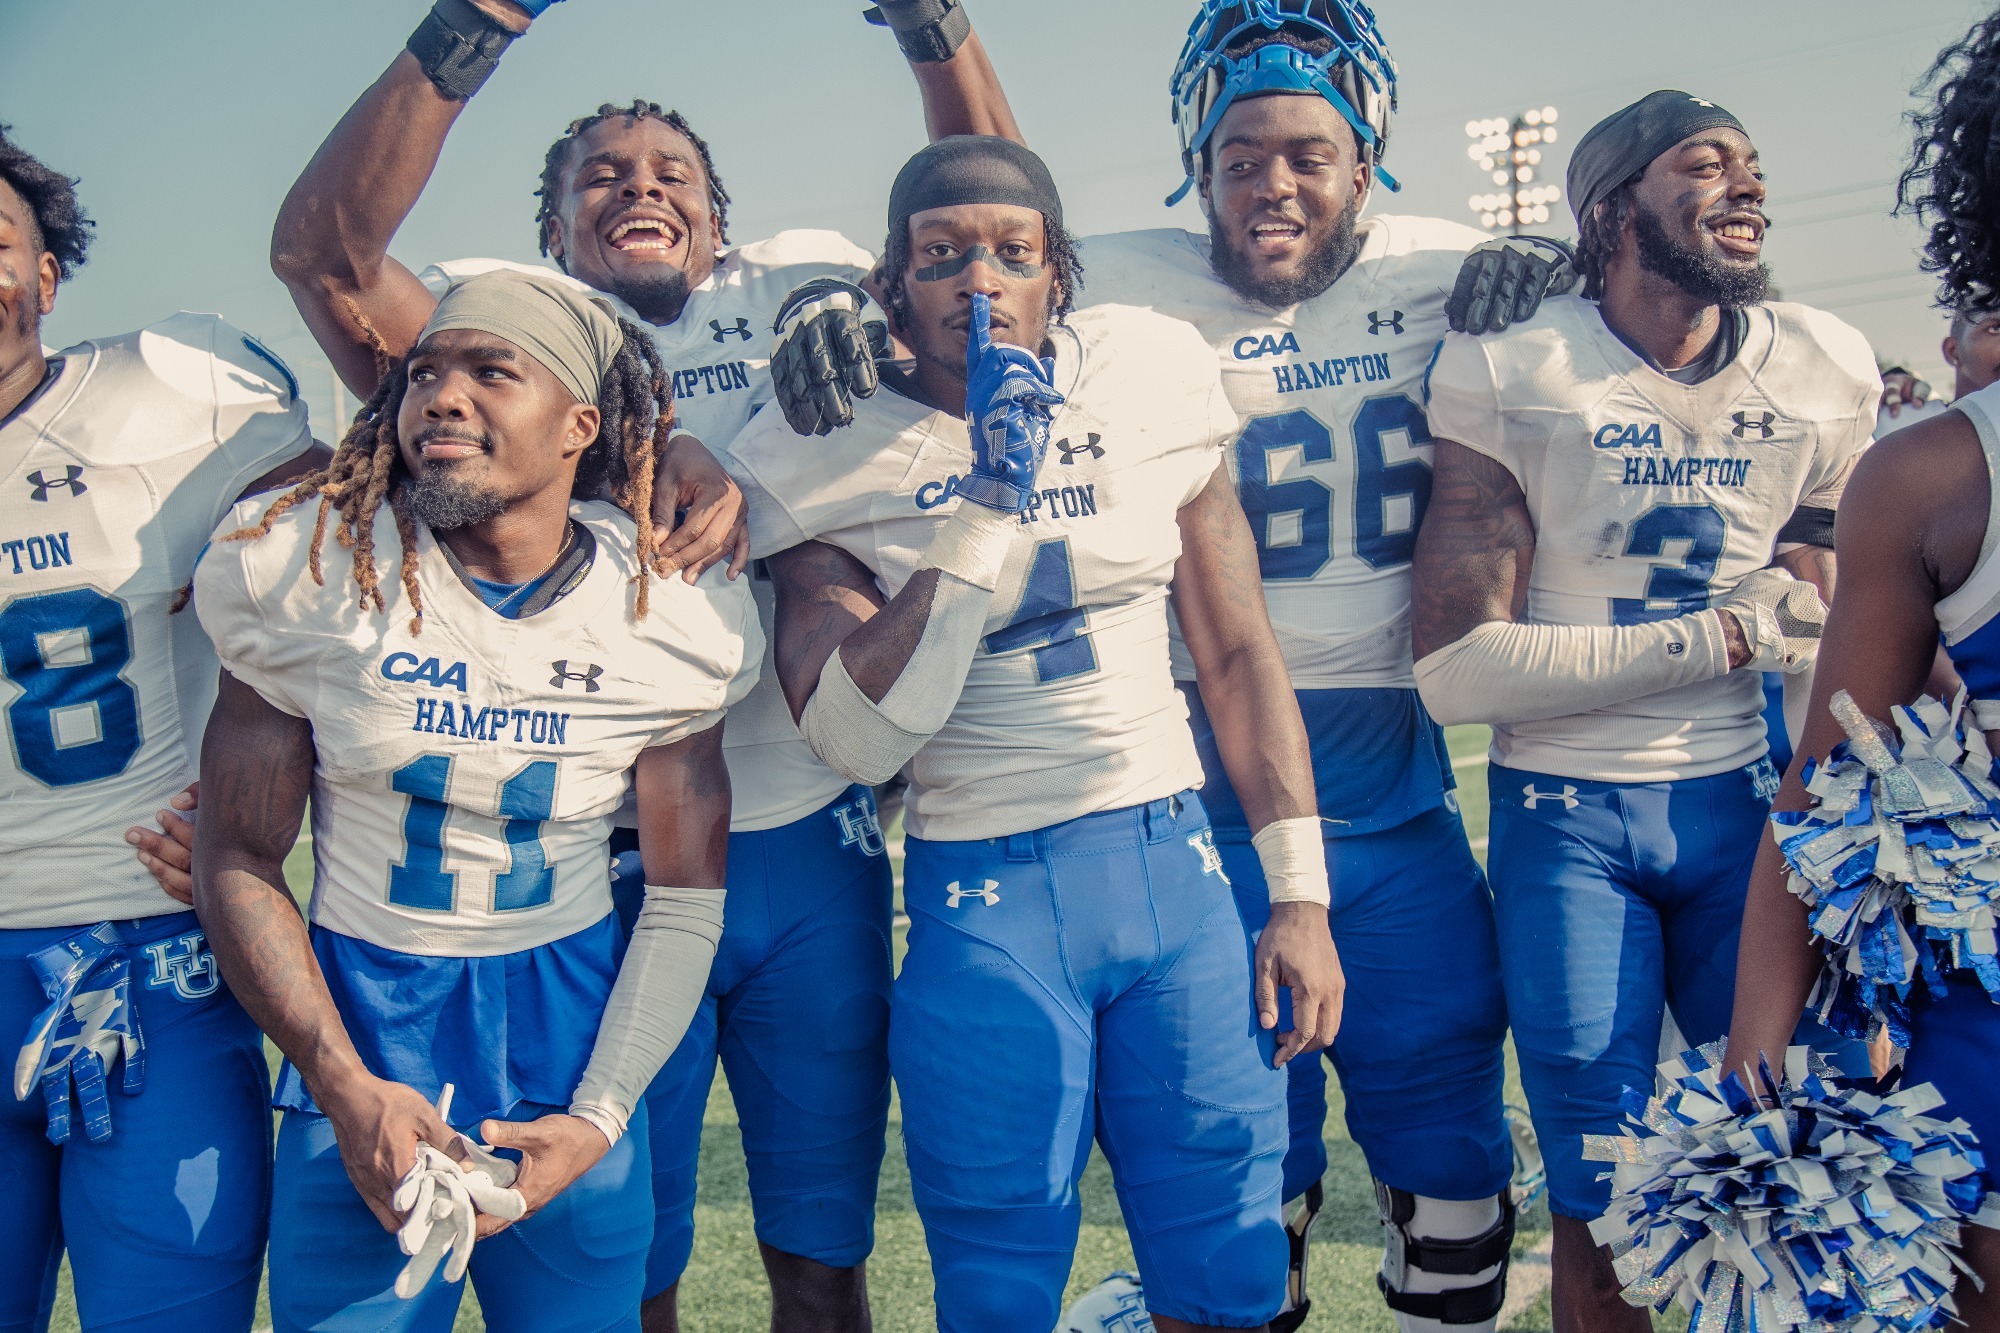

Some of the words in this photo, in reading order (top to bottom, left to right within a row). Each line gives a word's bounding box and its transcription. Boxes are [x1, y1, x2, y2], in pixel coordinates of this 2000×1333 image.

[1233, 332, 1301, 360] CAA
[1273, 352, 1391, 393] HAMPTON
[1593, 423, 1663, 449] CAA
[915, 474, 962, 510] CA
[1232, 391, 1436, 583] 66
[1622, 457, 1751, 487] HAMPTON
[1020, 483, 1098, 525] PTON
[0, 531, 73, 575] TON
[1606, 502, 1729, 628] 3
[979, 534, 1101, 686] 4
[0, 582, 146, 791] 8
[380, 651, 468, 693] CAA
[412, 697, 570, 745] HAMPTON
[384, 750, 563, 917] 11
[145, 932, 221, 1000] HU
